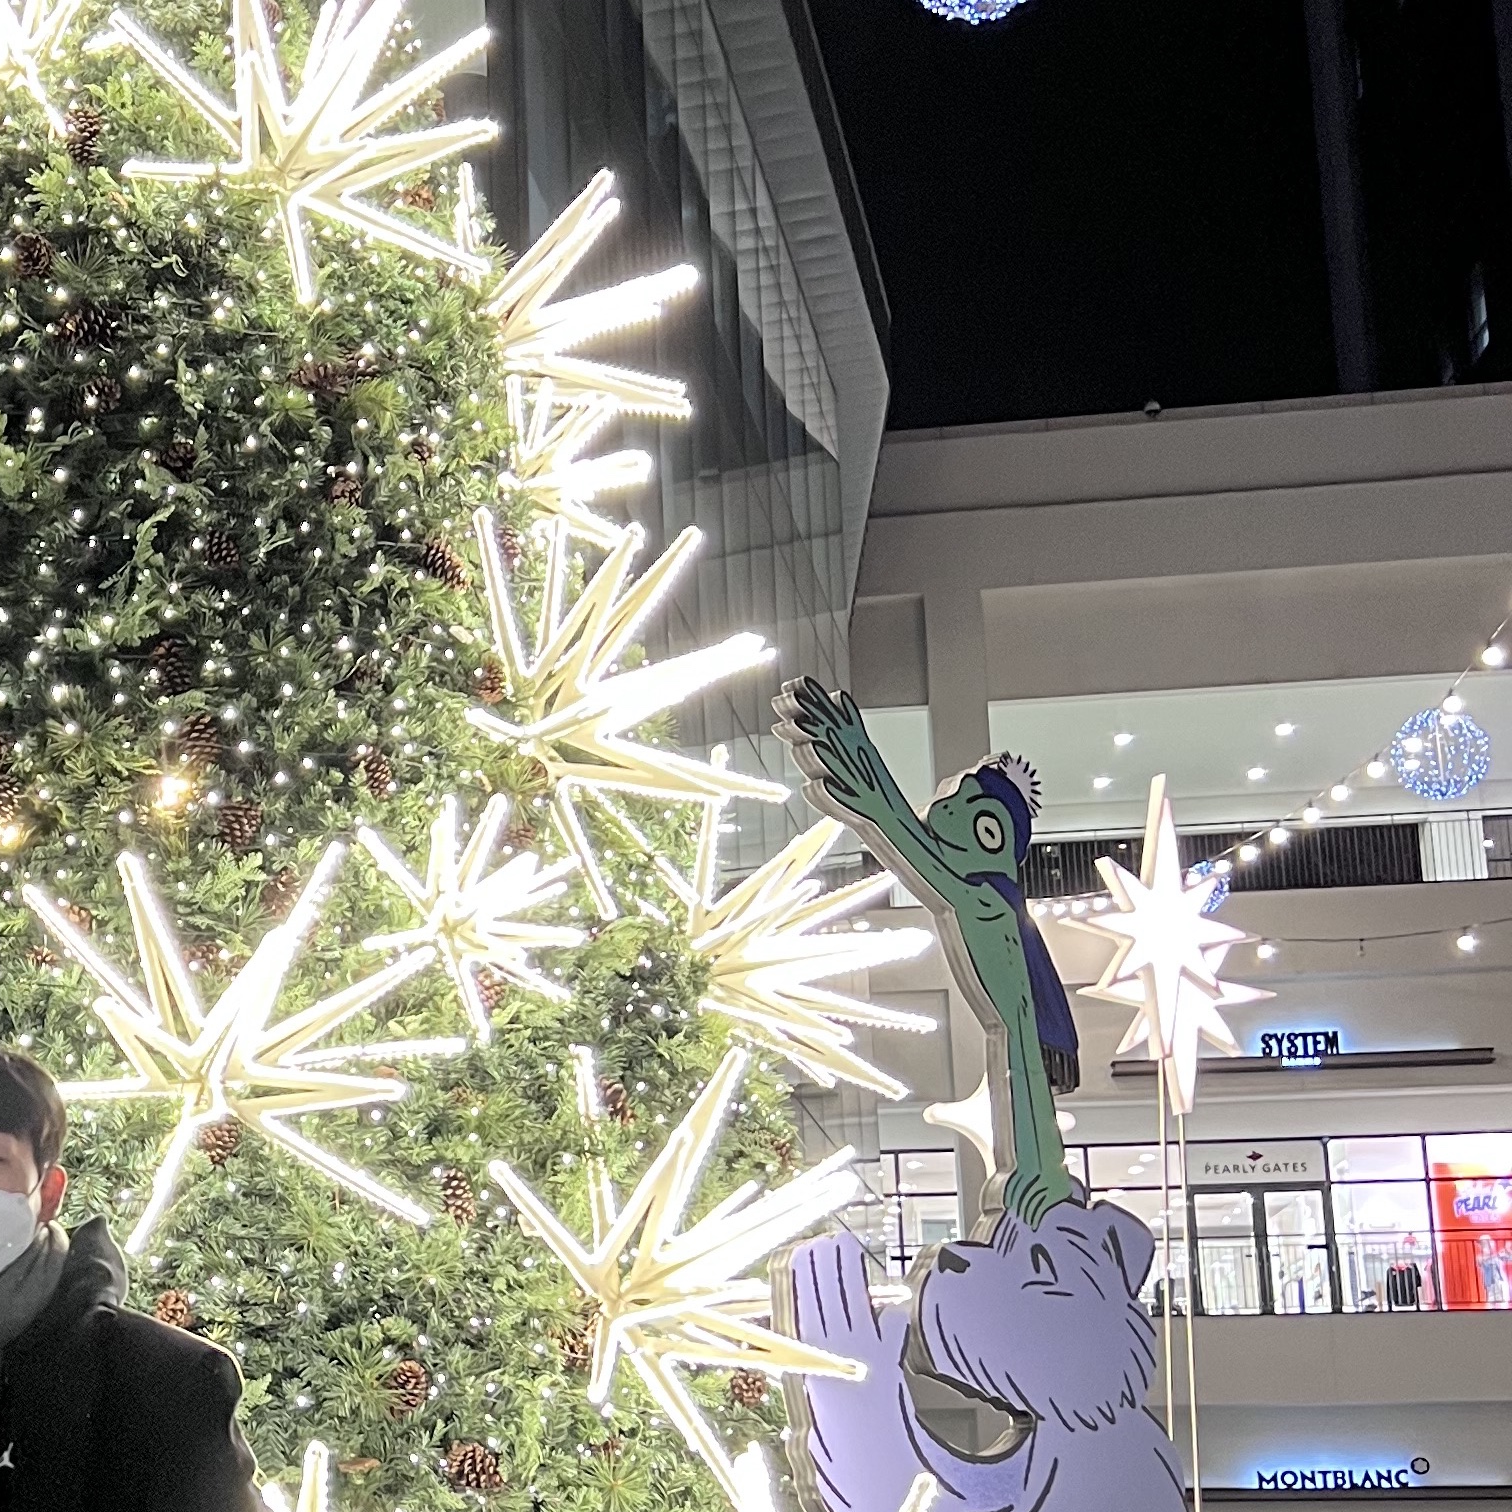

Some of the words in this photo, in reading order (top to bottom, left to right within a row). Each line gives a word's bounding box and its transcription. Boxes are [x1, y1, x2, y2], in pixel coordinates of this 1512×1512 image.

[1261, 1031, 1339, 1057] SYSTEM
[1204, 1163, 1256, 1174] PEARLY
[1262, 1162, 1307, 1173] GATES
[1257, 1469, 1409, 1490] MONTBLANC
